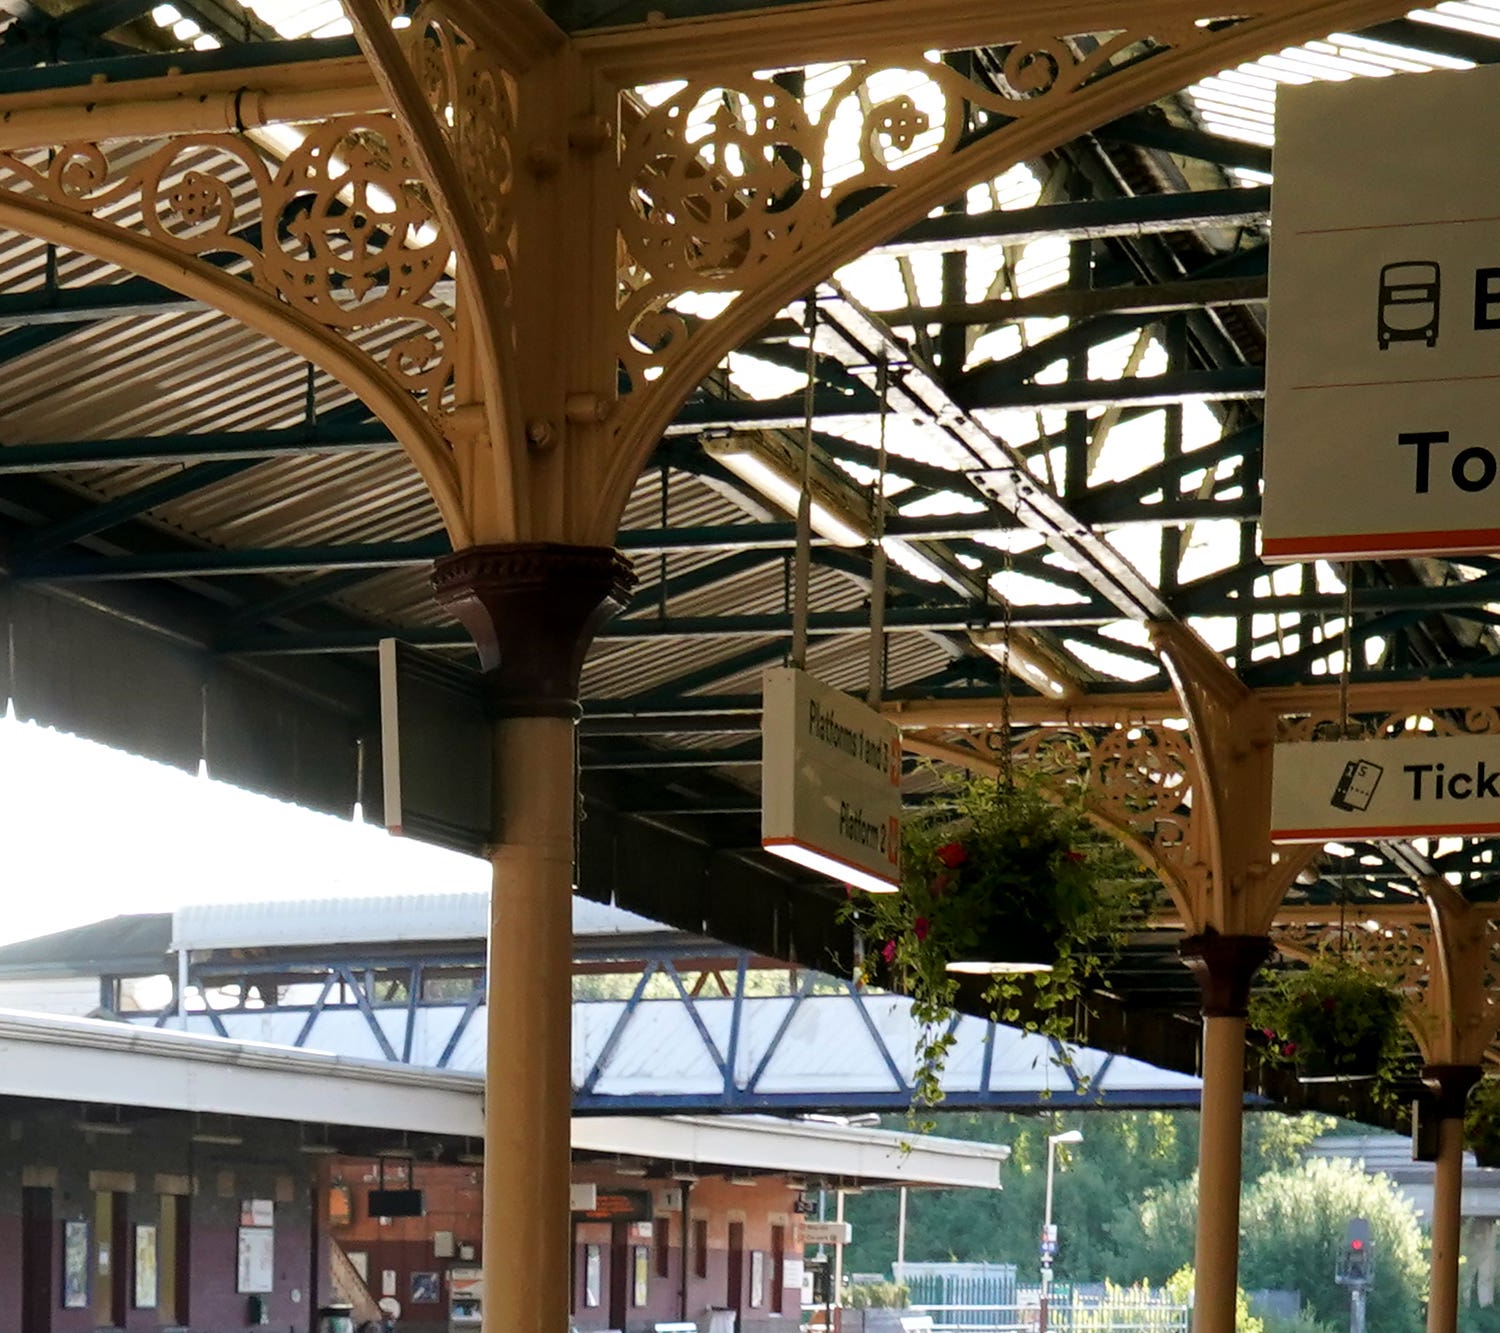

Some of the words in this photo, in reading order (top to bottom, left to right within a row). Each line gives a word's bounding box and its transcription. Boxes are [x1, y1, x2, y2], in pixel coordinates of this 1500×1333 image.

[809, 699, 858, 757] Platforms
[865, 738, 882, 770] and
[839, 800, 879, 850] Platform
[880, 823, 887, 853] 2
